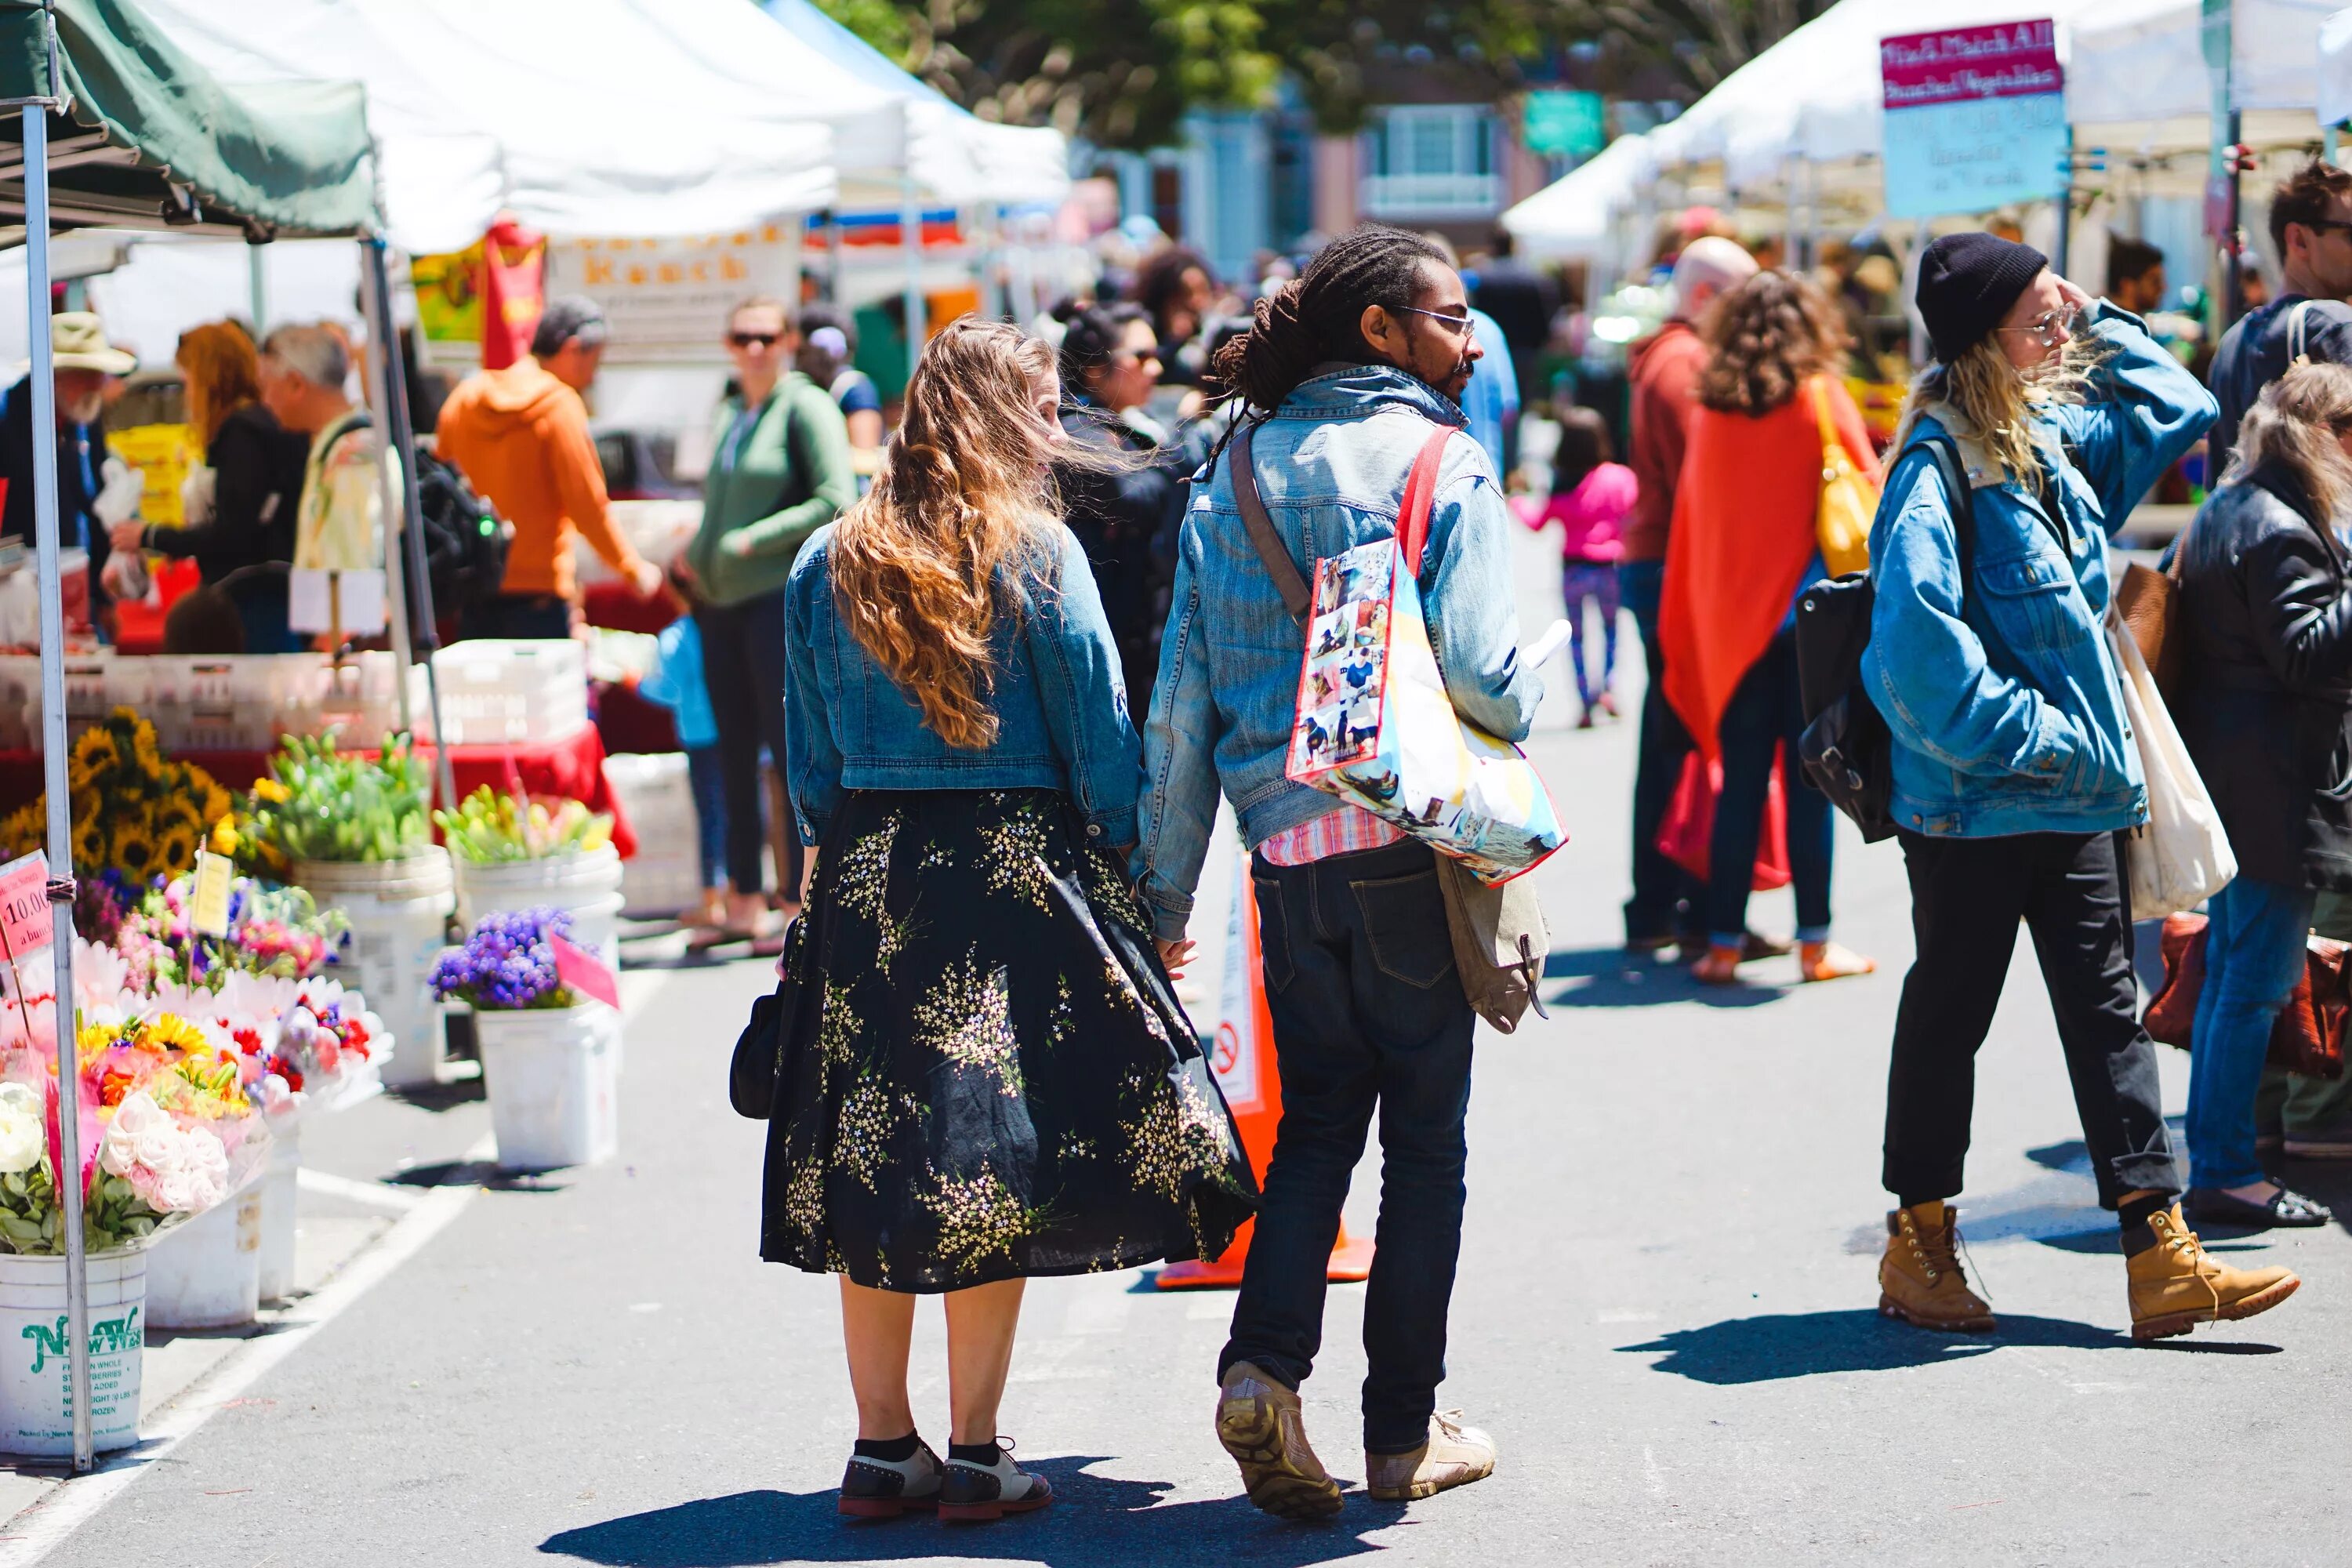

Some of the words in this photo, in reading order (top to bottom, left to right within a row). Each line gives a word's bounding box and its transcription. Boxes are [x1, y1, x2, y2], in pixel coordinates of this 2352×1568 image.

[2013, 20, 2053, 49] All
[1959, 64, 2056, 96] Vegetables
[584, 252, 749, 285] Ranch
[20, 935, 27, 946] a
[96, 1359, 122, 1369] WHOLE
[93, 1381, 118, 1390] ADDED
[90, 1395, 110, 1403] EIGHT
[91, 1406, 116, 1416] ROZEN
